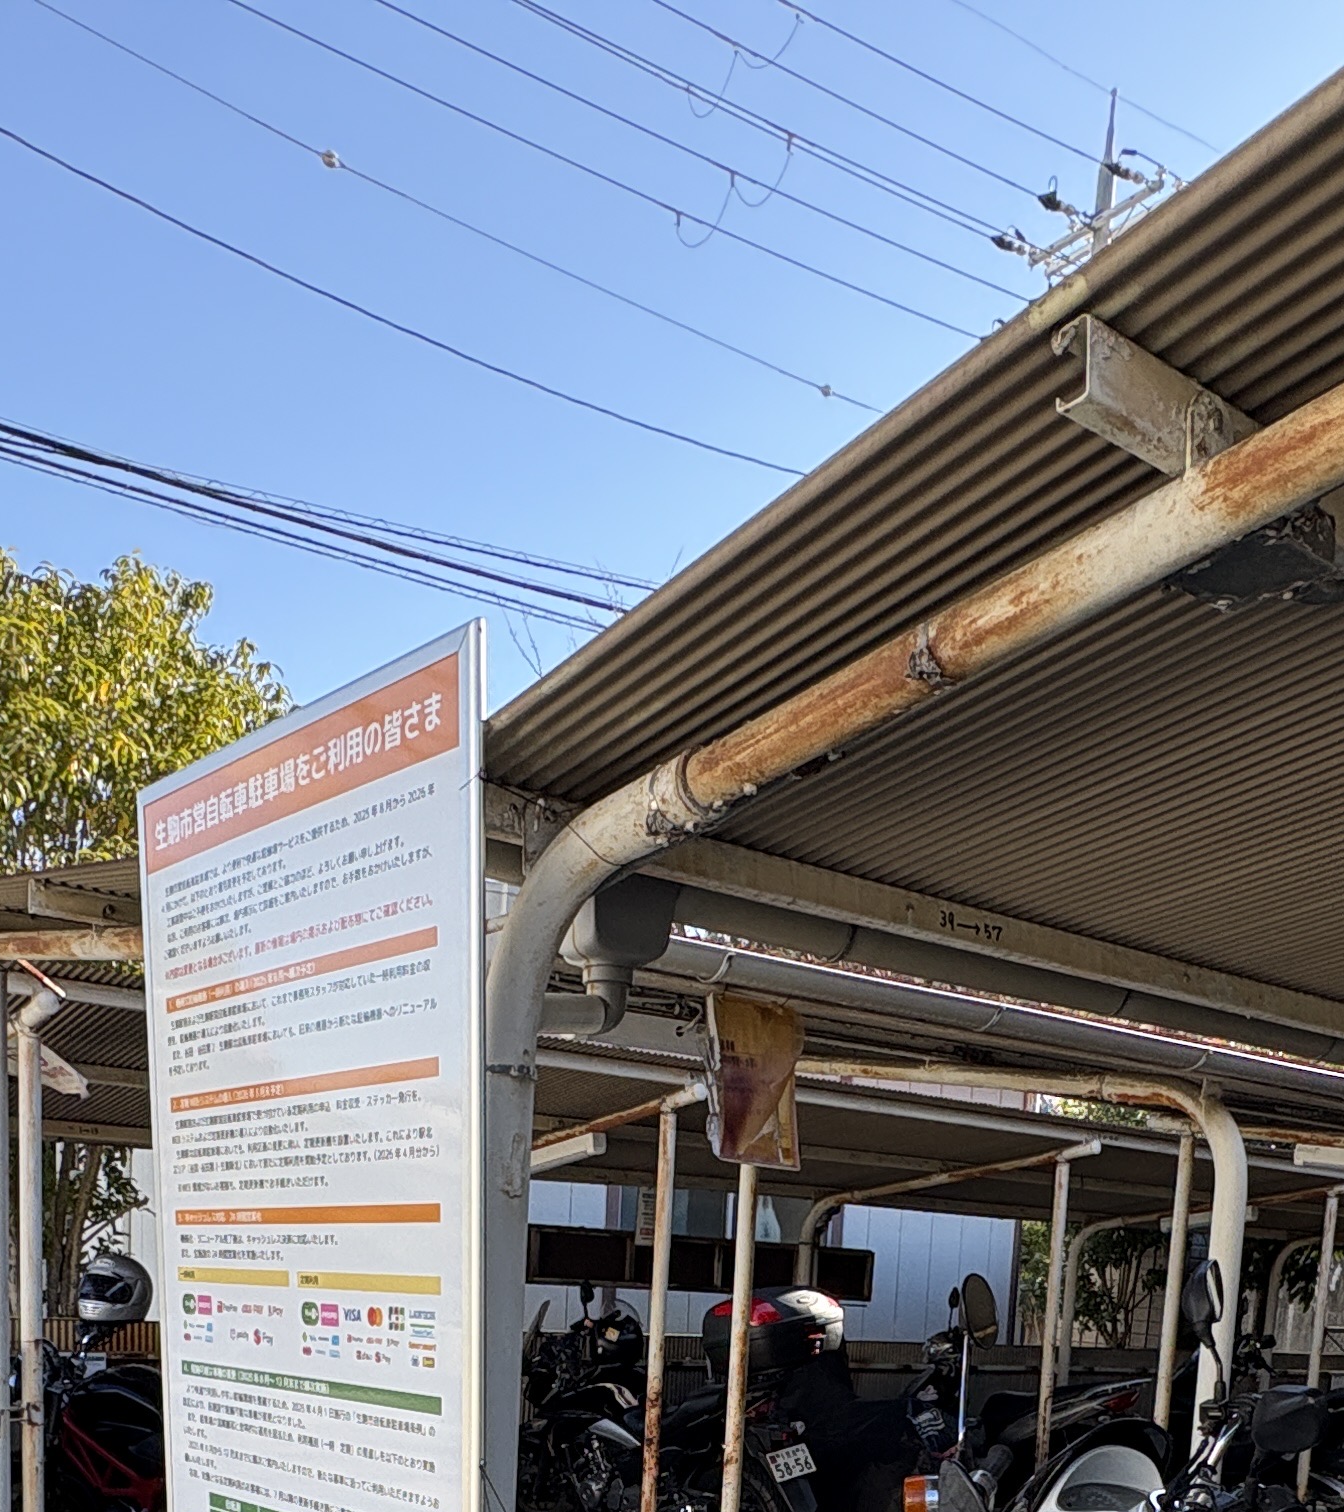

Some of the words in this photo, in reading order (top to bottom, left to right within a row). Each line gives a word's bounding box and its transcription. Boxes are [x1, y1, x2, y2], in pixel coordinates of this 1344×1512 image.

[154, 691, 441, 851] 生駒市営自転車駐車場をご利用の皆さま
[984, 923, 1003, 942] 57
[343, 1307, 361, 1323] VISA
